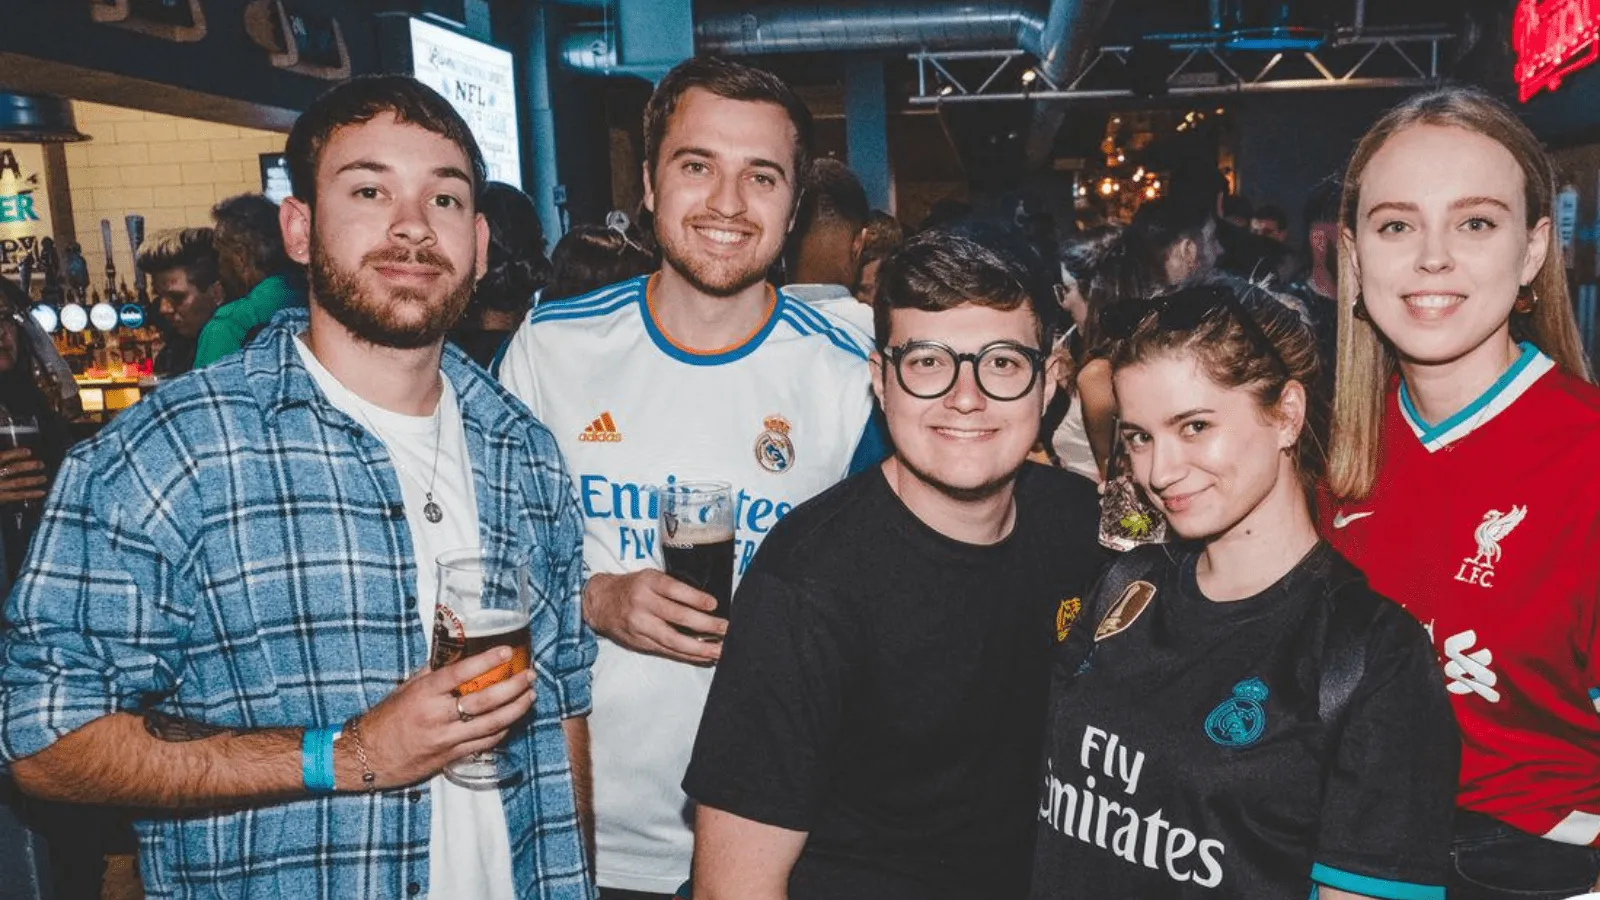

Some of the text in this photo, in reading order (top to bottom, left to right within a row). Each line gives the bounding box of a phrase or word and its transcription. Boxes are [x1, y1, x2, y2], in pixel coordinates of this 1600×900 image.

[455, 80, 486, 107] NFL
[578, 432, 622, 443] adidas
[619, 526, 655, 560] FLY
[1080, 725, 1145, 794] Fly
